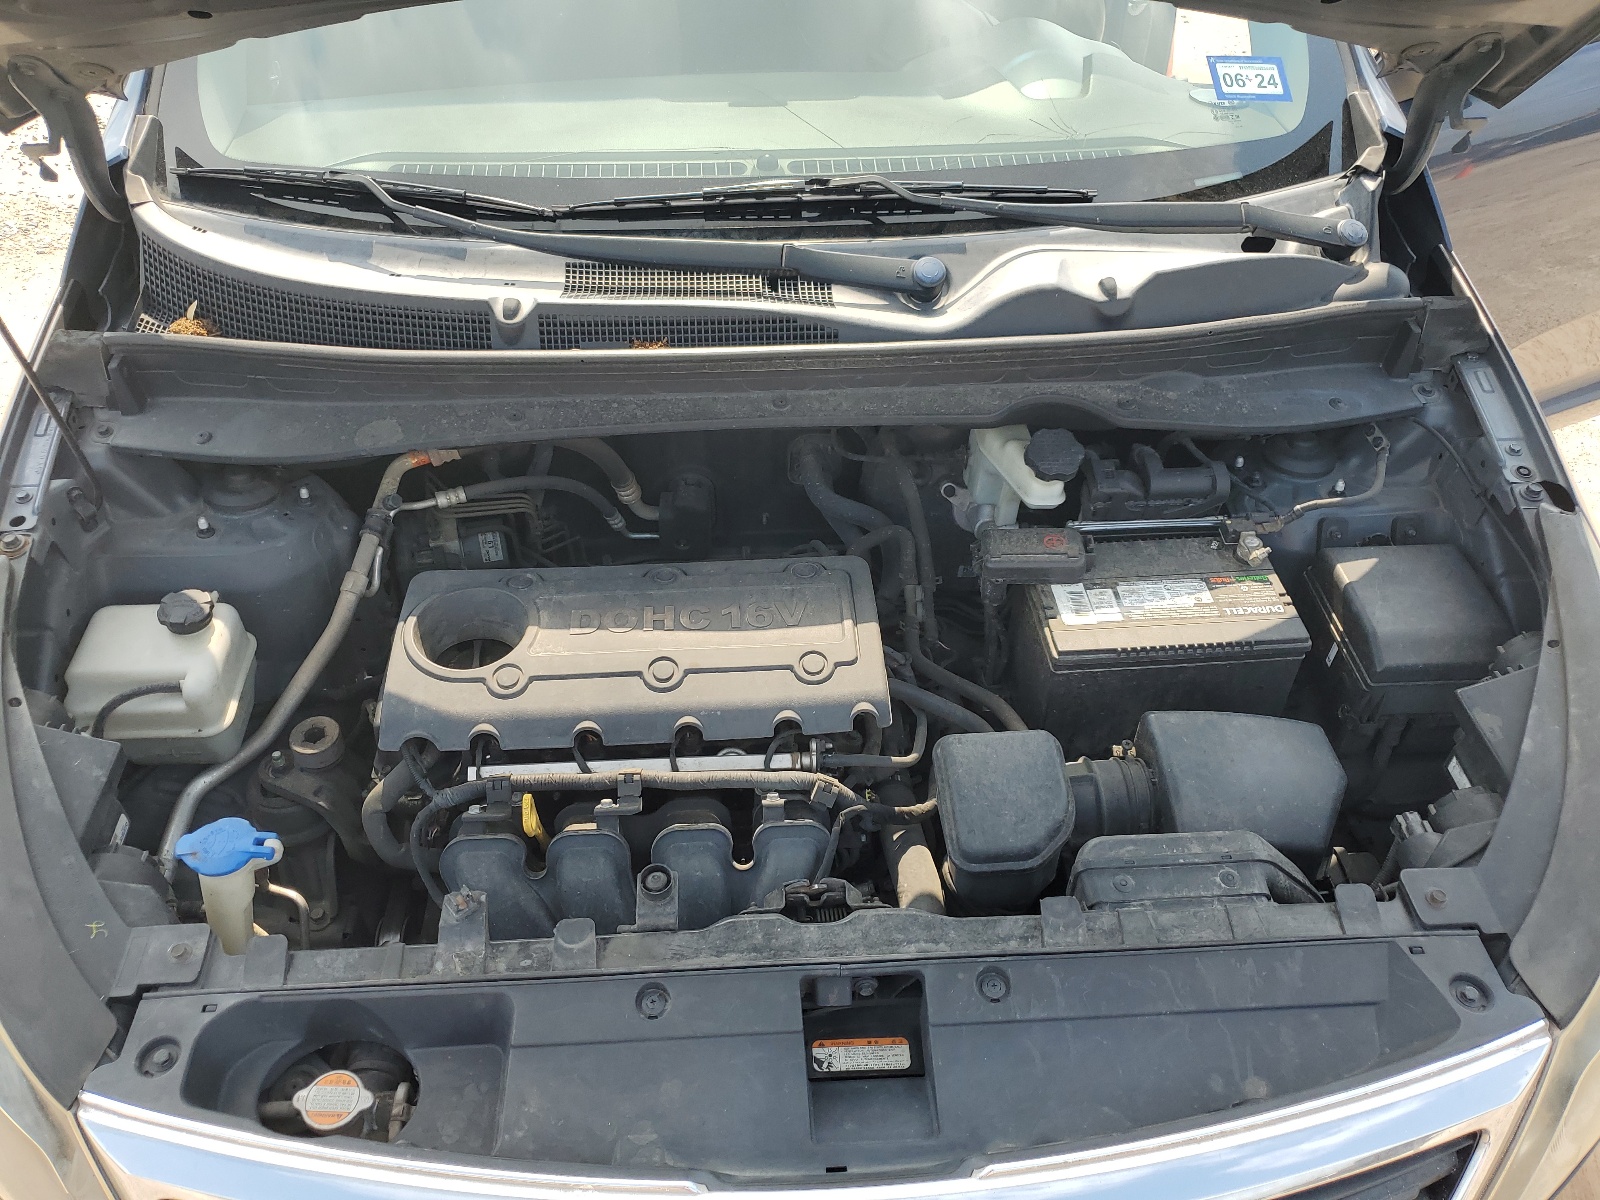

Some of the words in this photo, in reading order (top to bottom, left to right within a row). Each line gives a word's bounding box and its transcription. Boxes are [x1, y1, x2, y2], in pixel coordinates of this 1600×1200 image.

[1222, 72, 1246, 88] 06
[1254, 73, 1279, 89] 24
[569, 605, 712, 635] DOHC
[721, 600, 810, 629] 16V
[1222, 604, 1285, 616] DURACELL
